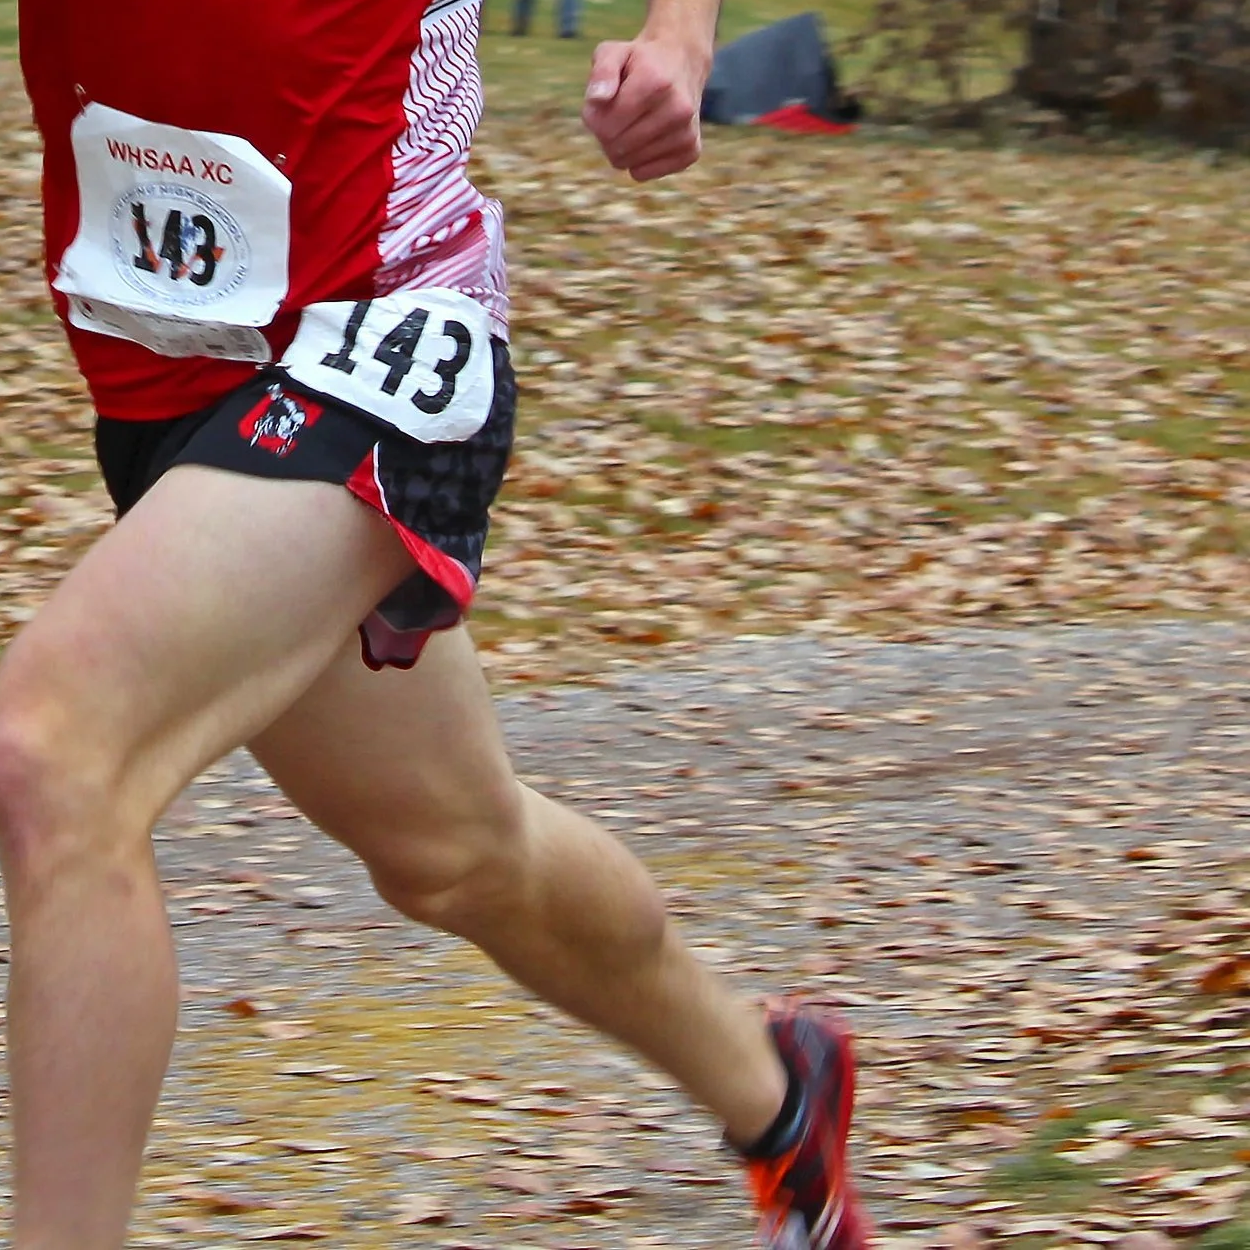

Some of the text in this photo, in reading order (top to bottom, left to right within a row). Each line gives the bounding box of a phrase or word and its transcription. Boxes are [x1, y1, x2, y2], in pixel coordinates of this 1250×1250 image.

[105, 136, 233, 185] WHSAA XC
[131, 201, 216, 286] 143
[320, 300, 472, 415] 143
